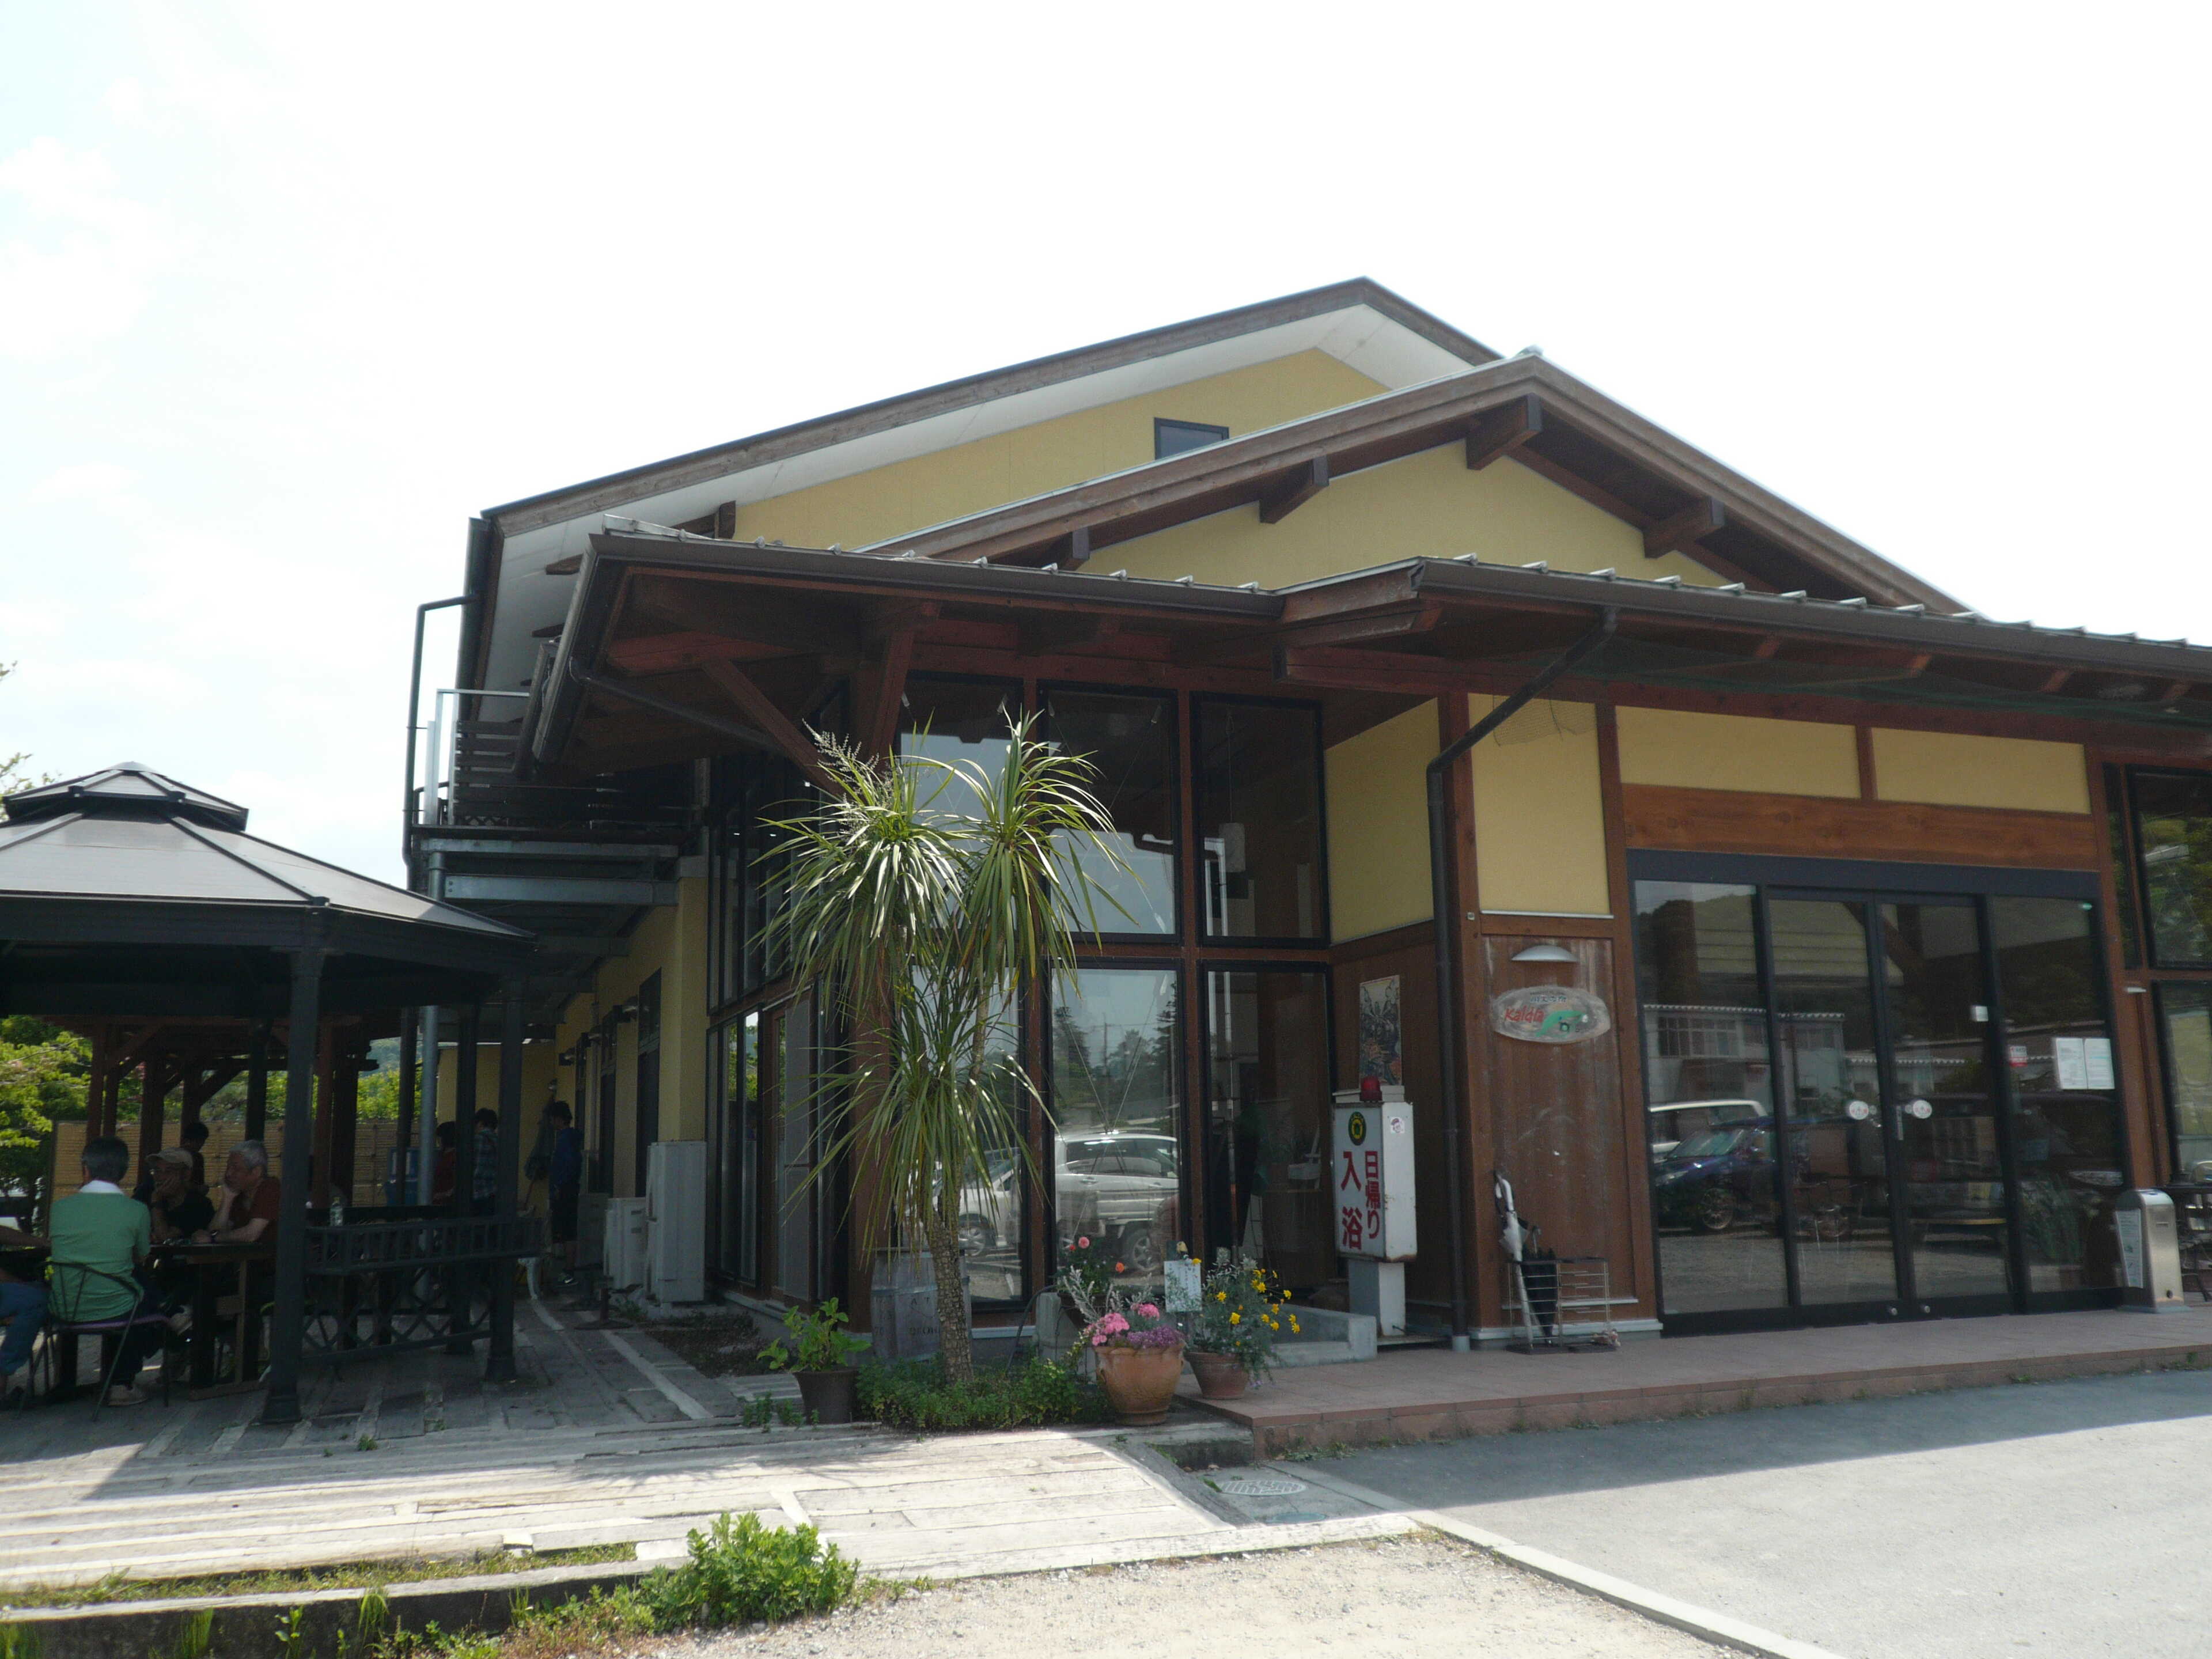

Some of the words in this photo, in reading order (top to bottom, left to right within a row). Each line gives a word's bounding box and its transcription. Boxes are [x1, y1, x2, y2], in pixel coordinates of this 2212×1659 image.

[1341, 1151, 1362, 1249] 入浴
[1365, 1151, 1380, 1238] 日帰り
